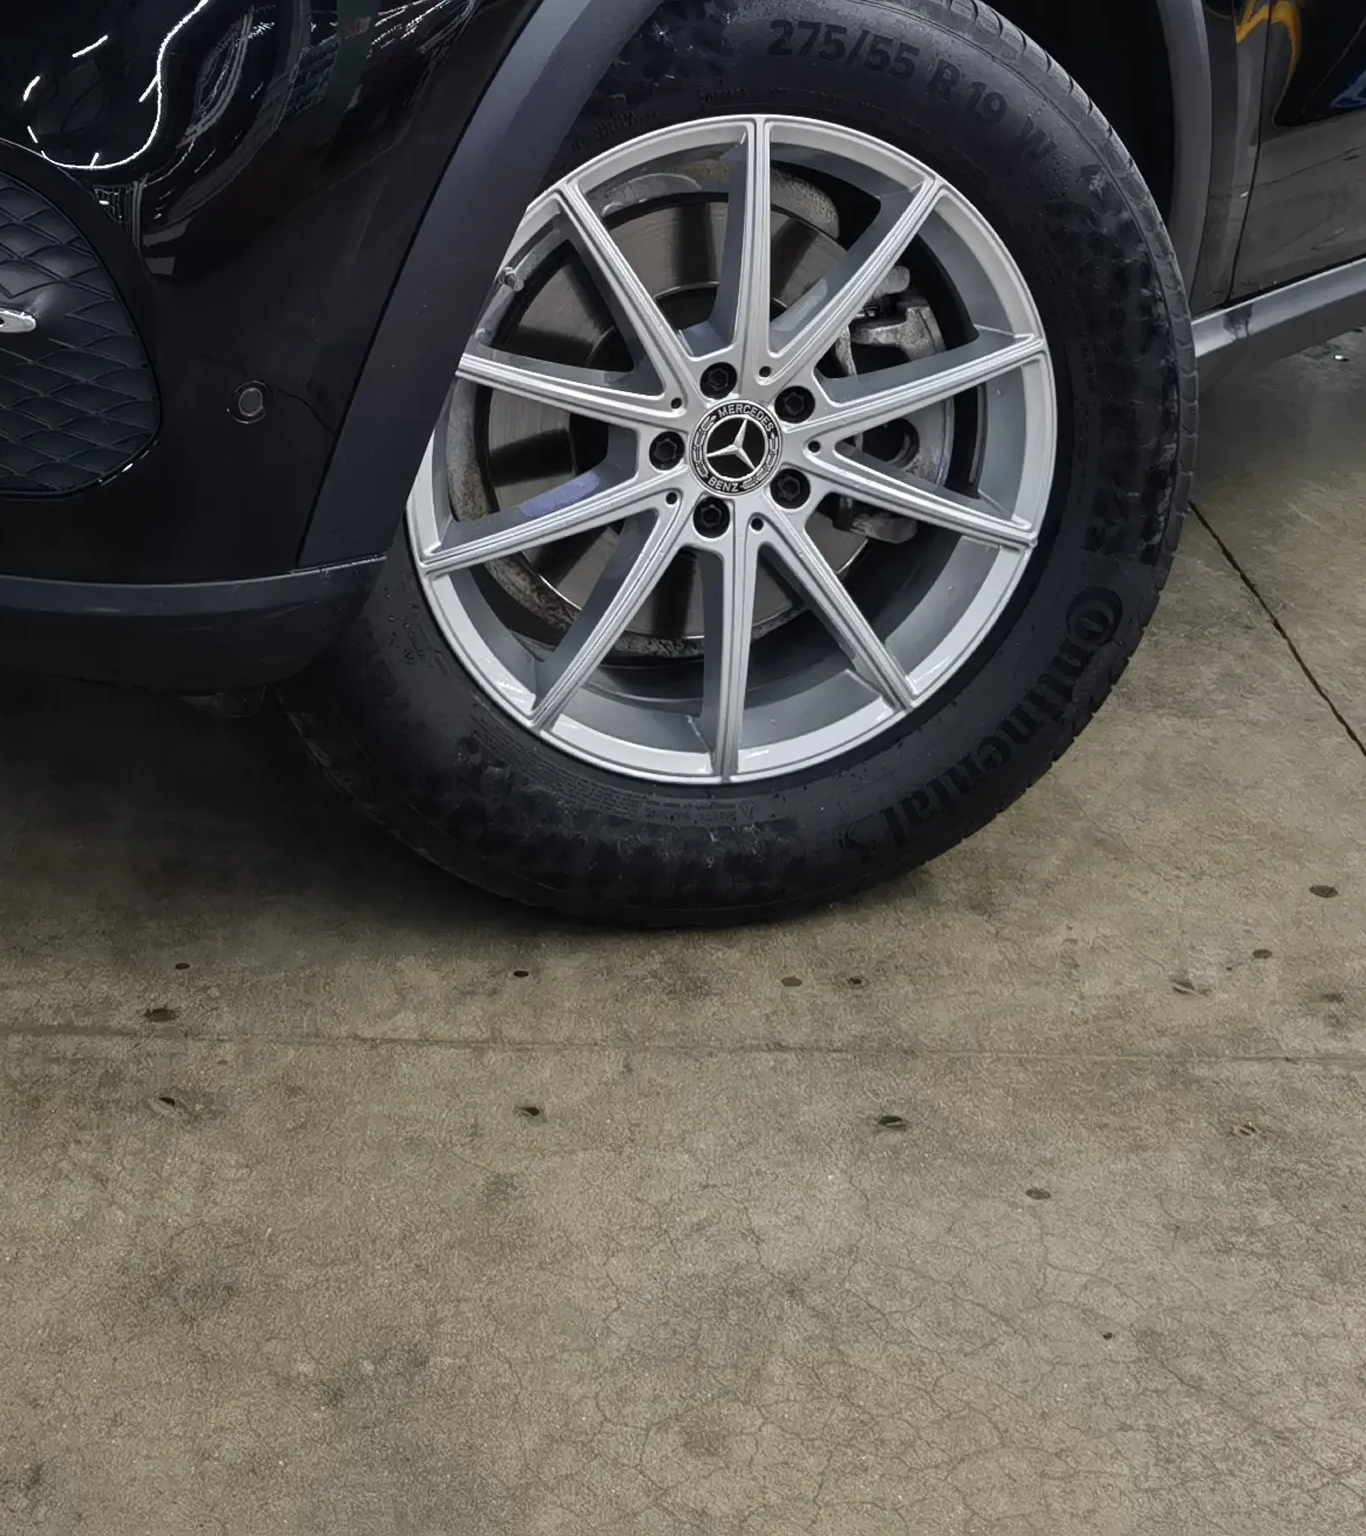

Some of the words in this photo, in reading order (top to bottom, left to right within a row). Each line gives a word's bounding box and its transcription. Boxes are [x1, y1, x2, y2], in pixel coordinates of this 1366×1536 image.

[767, 19, 920, 80] 275/55
[927, 58, 961, 103] R
[718, 404, 774, 432] MERCEDES
[707, 476, 739, 492] BENZ
